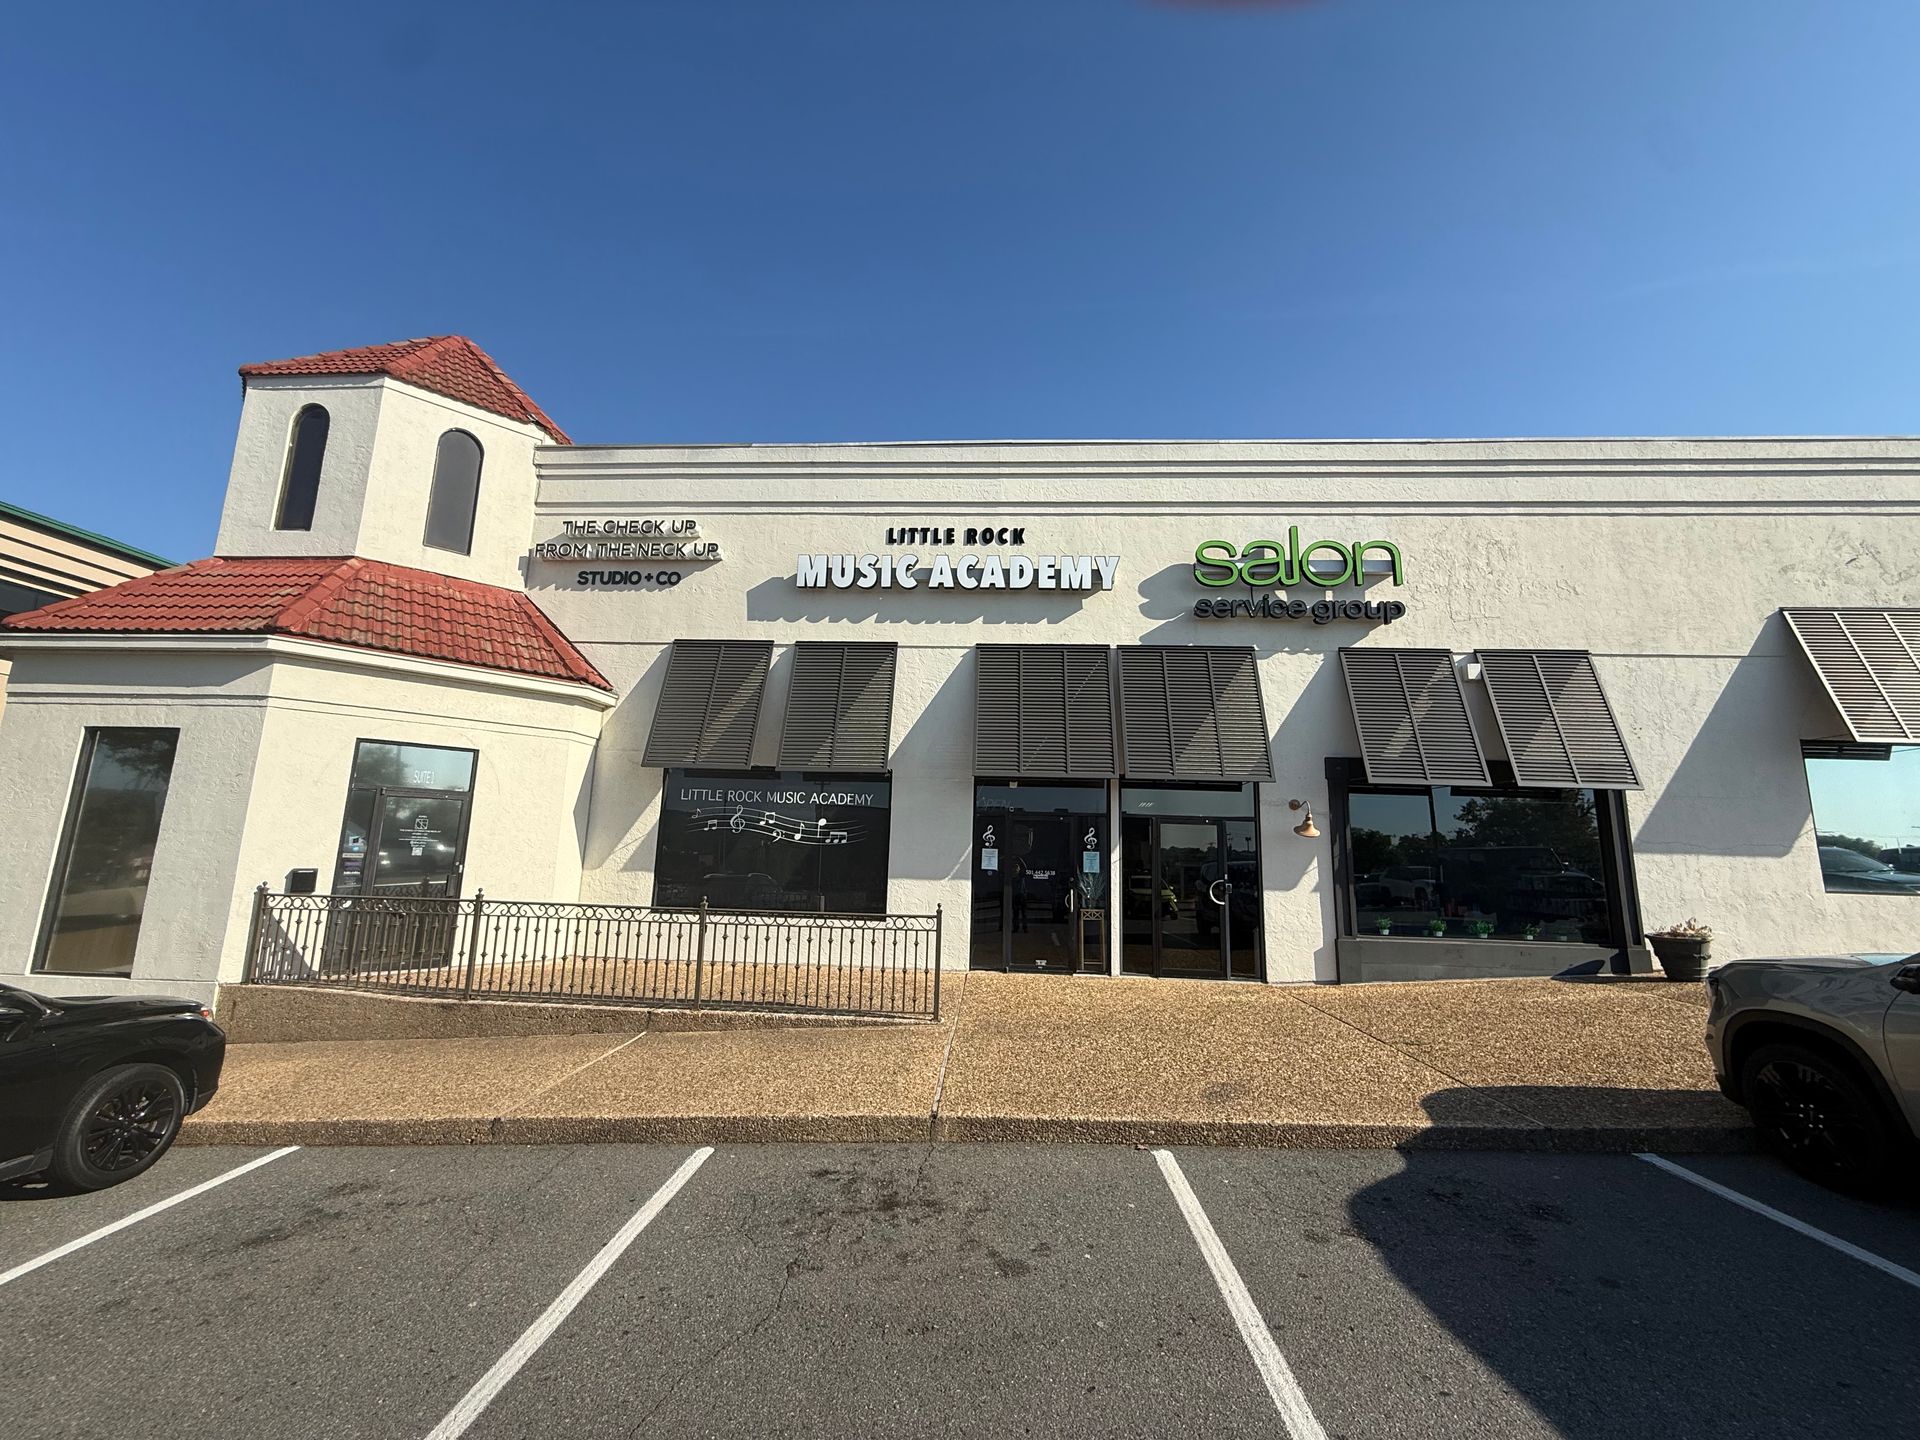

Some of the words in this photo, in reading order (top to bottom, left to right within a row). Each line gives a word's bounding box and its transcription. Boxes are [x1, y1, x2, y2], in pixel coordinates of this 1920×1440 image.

[563, 520, 598, 535] THE
[602, 520, 665, 534] CHECK
[671, 520, 697, 534] UP
[888, 527, 955, 545] LITTLE
[966, 527, 1026, 545] ROCK
[534, 543, 589, 558] FROM
[596, 543, 632, 557] THE
[636, 543, 688, 557] NECK
[693, 543, 719, 557] UP
[1194, 525, 1404, 587] salon
[796, 554, 920, 588] MUSIC
[928, 555, 1120, 590] ACADEMY
[1194, 593, 1308, 619] service
[1311, 599, 1406, 625] group
[680, 788, 724, 801] LITTLE
[727, 790, 762, 803] ROCK
[766, 791, 806, 805] MUSIC
[809, 792, 875, 806] ACADEMY
